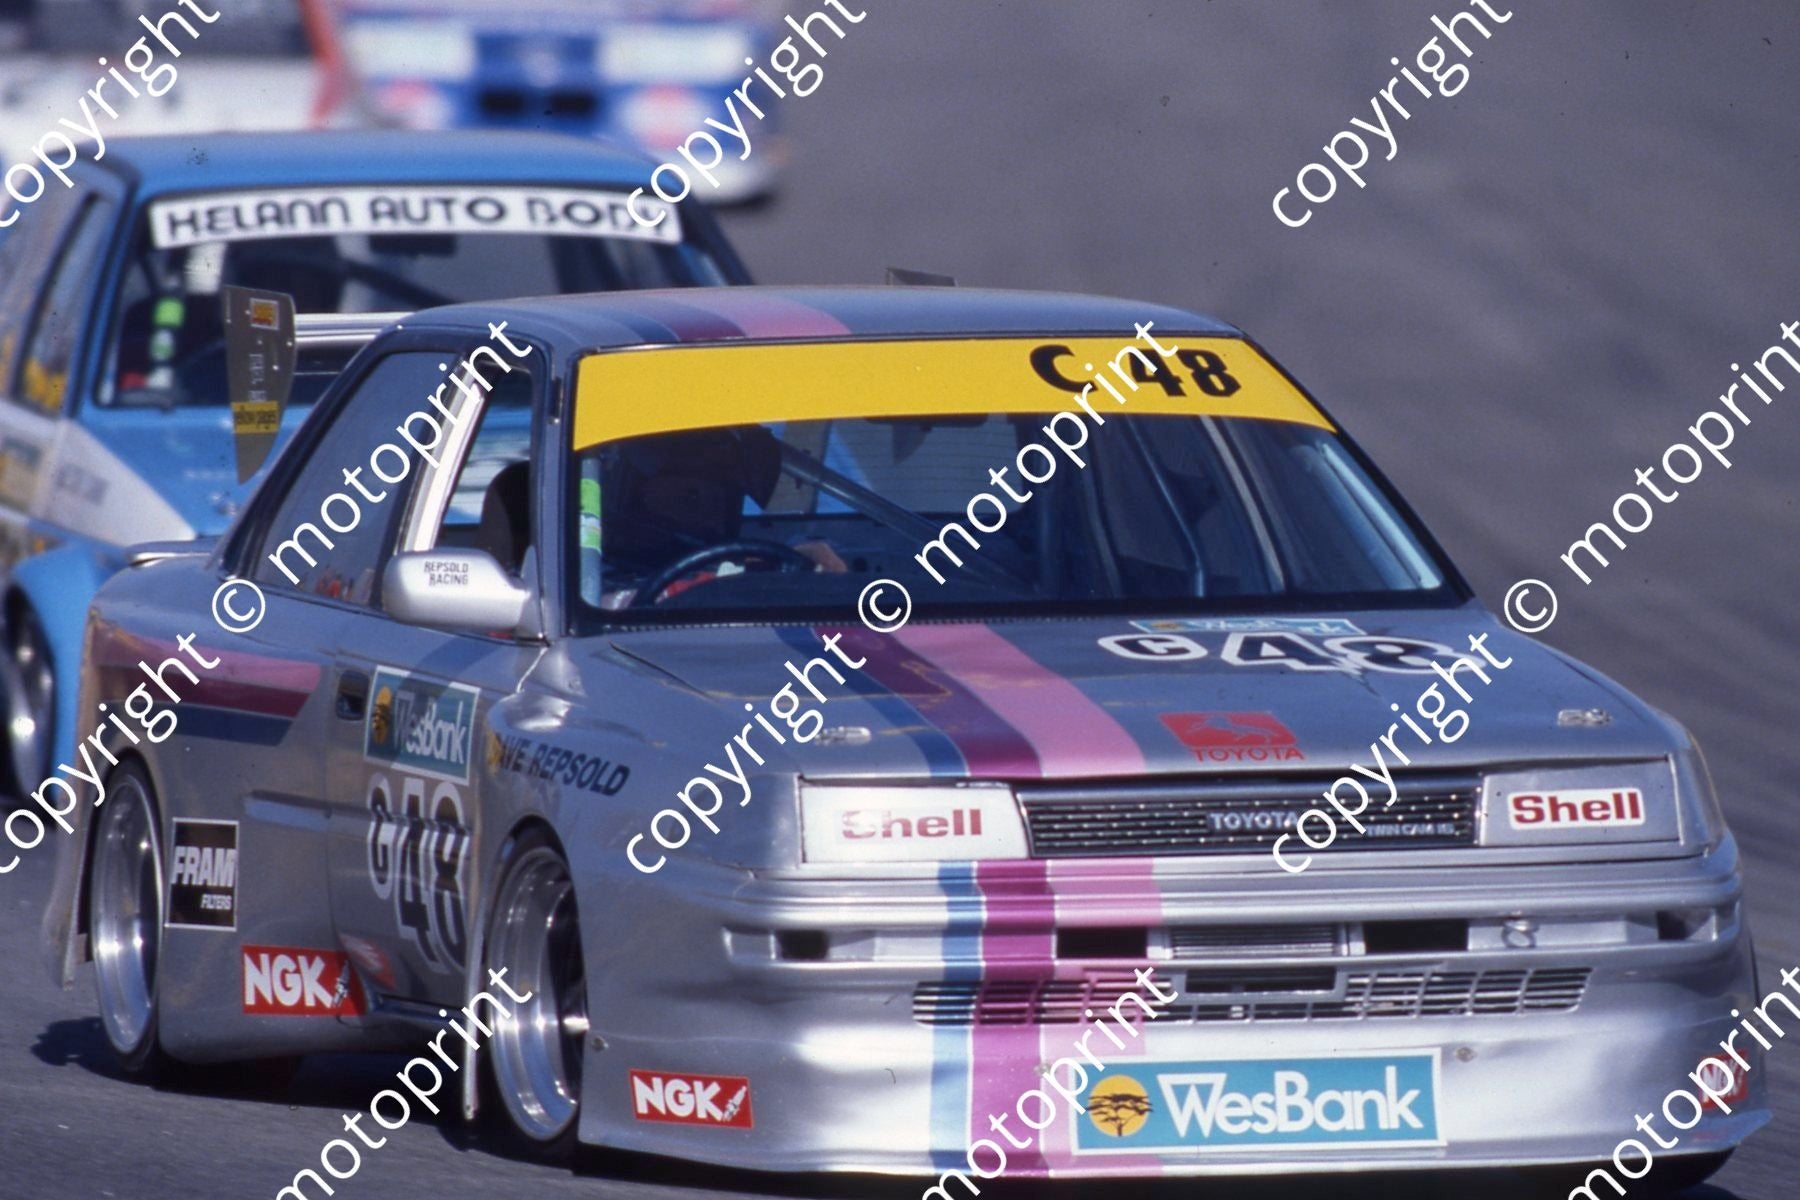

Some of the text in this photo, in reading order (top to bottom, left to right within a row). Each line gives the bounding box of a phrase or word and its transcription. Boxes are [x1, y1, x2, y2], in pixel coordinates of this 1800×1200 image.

[167, 199, 348, 239] HELANN
[369, 196, 505, 226] AUTO
[1029, 344, 1242, 397] C 48
[424, 561, 469, 574] REPSOLD
[428, 573, 469, 586] RACING
[527, 742, 631, 797] REPSOLD
[1192, 746, 1305, 762] TOYOTA
[841, 808, 983, 839] Shell
[1209, 812, 1299, 831] TOYOTA
[1512, 790, 1642, 824] Shell
[171, 846, 238, 887] FRAM
[243, 952, 332, 1008] NGK
[632, 1075, 723, 1122] NGK
[1156, 1065, 1424, 1138] WesBank
